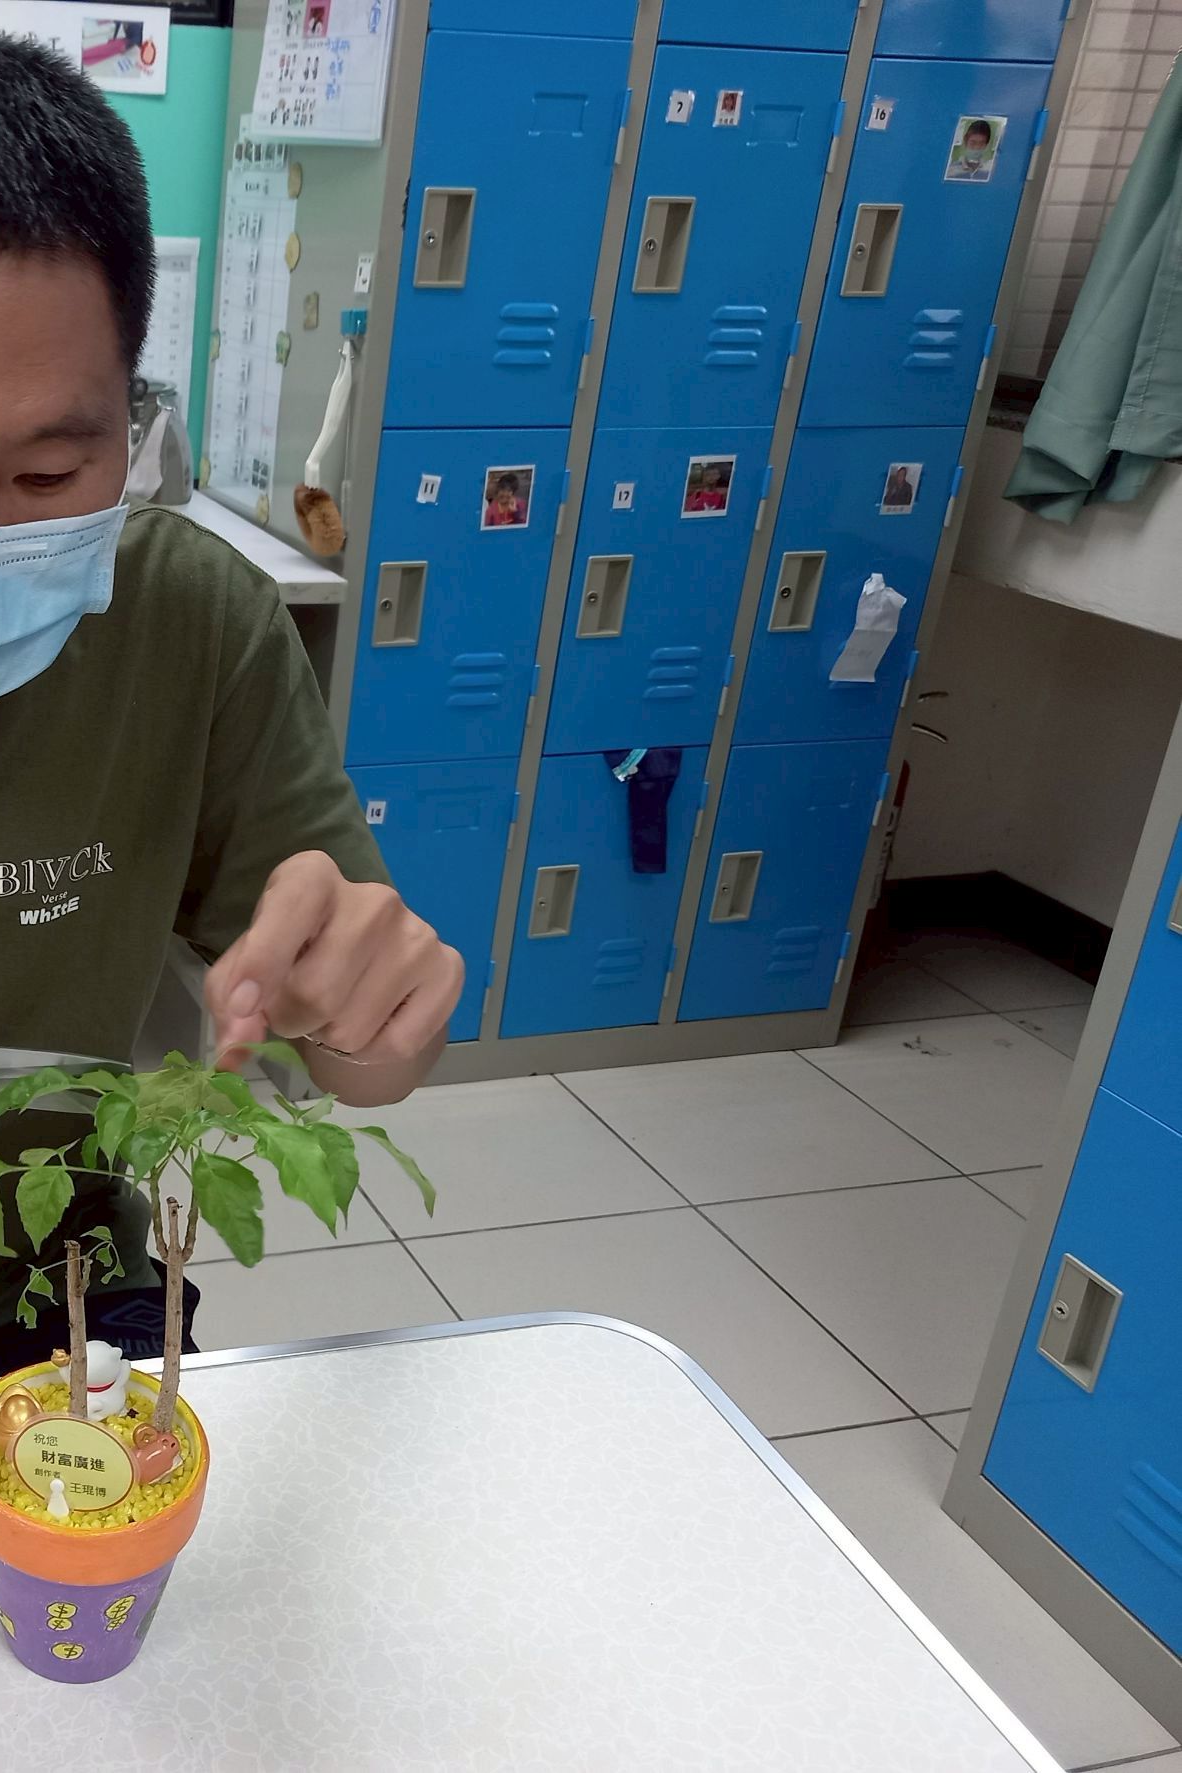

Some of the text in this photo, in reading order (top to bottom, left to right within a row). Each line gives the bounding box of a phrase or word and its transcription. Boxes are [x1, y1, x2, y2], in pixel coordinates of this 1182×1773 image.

[677, 101, 683, 113] 7
[875, 108, 886, 121] 16
[424, 482, 435, 495] 11
[618, 490, 630, 501] 17
[41, 890, 68, 904] Verse
[33, 1433, 58, 1446] 祝您
[41, 1449, 106, 1473] 財富廣進
[34, 1468, 61, 1479] 創作者
[69, 1482, 107, 1498] 王琨博
